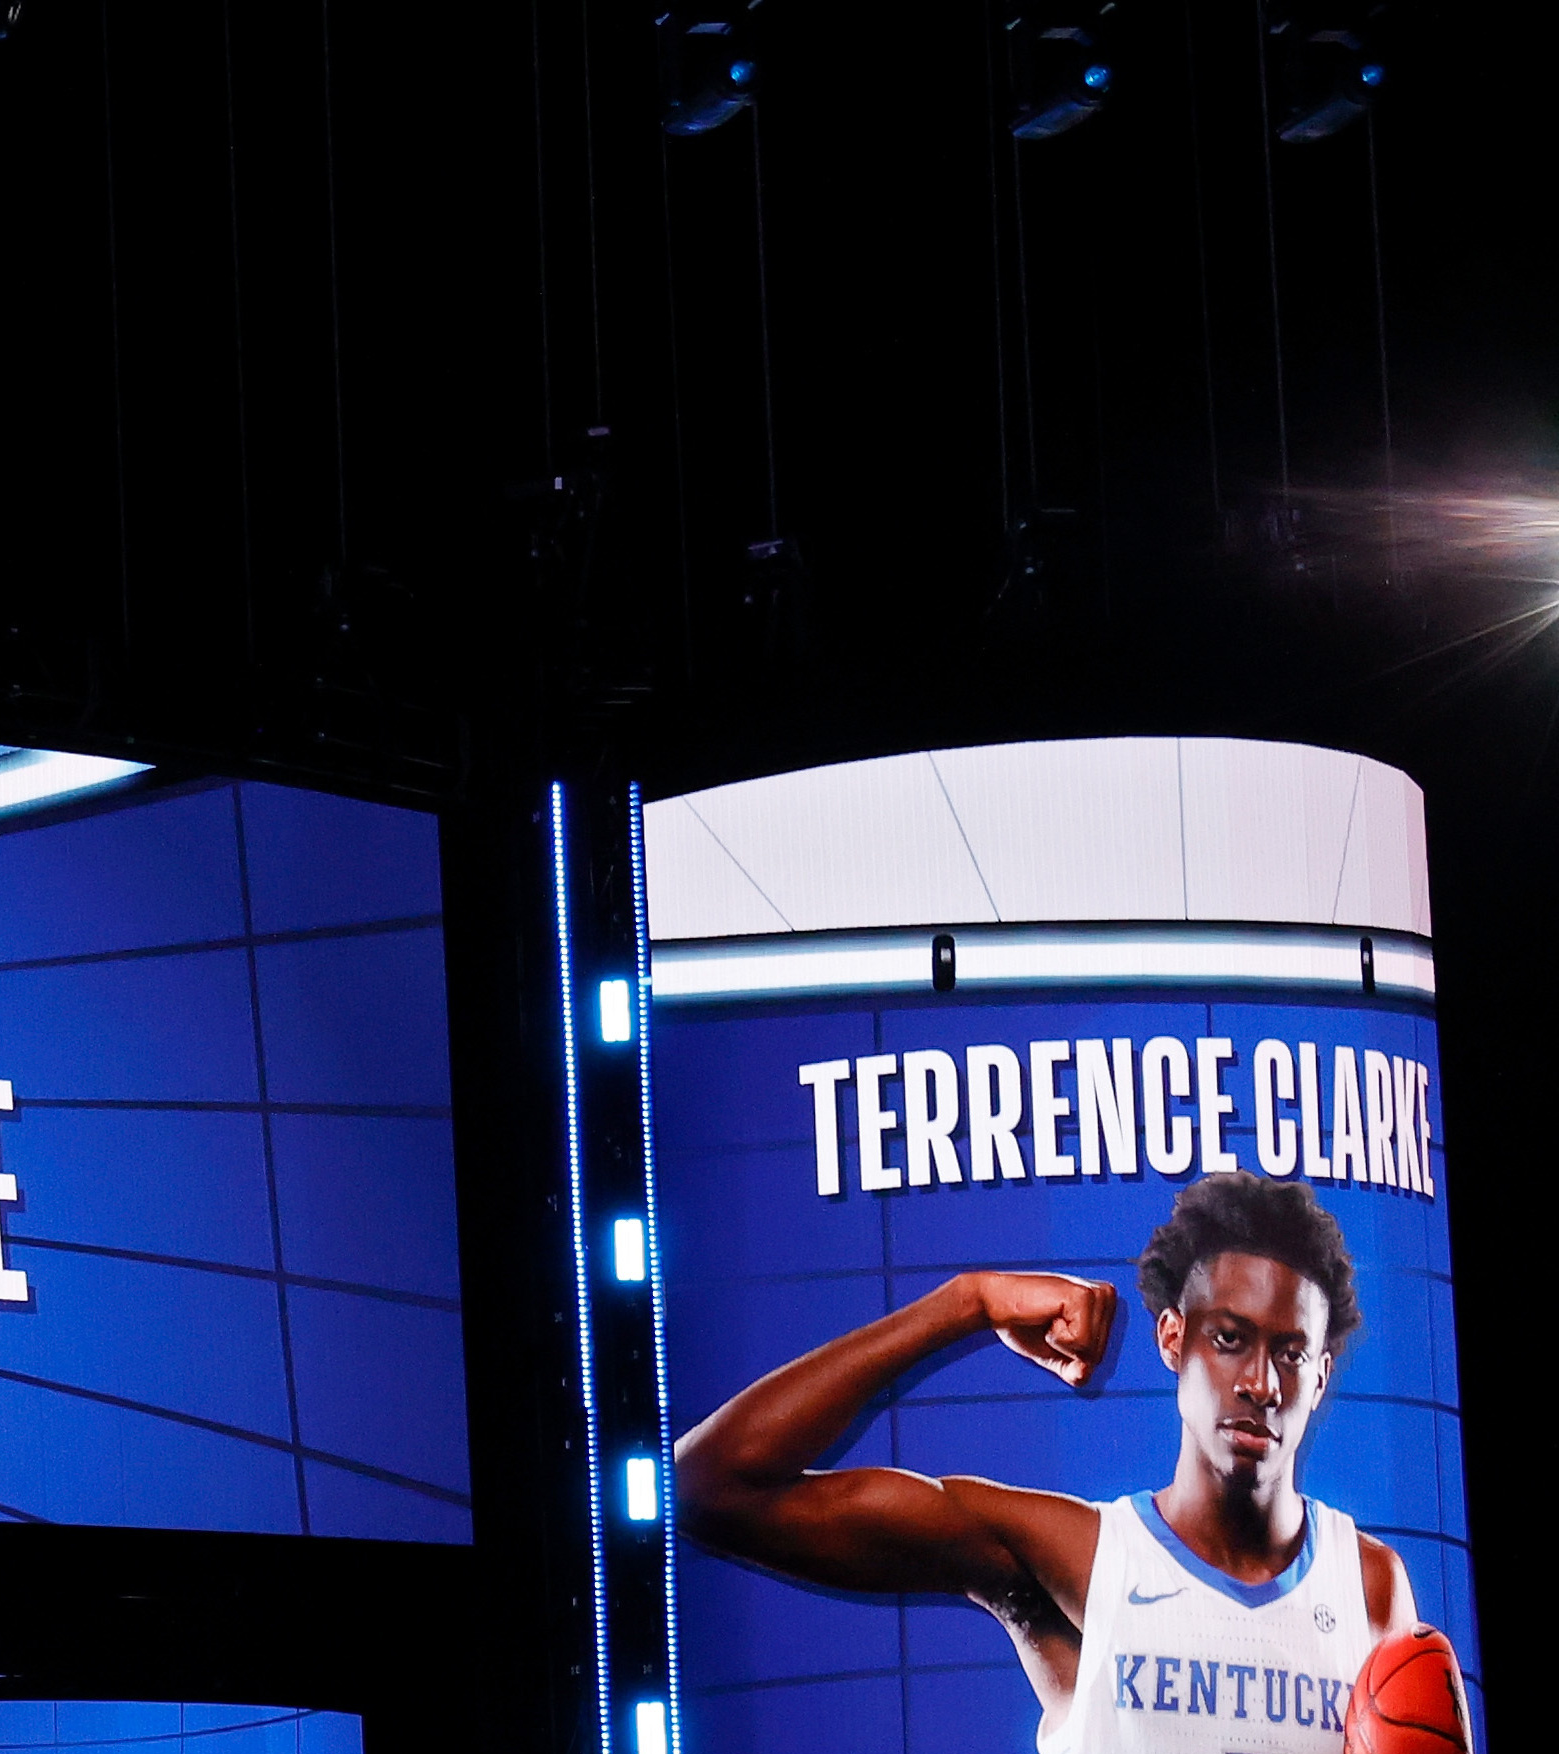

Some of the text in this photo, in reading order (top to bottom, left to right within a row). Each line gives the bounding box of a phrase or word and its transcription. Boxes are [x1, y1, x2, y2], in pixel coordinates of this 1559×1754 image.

[798, 1037, 1435, 1198] TERRENCE CLARKE
[1115, 1654, 1355, 1733] KENTUCK
